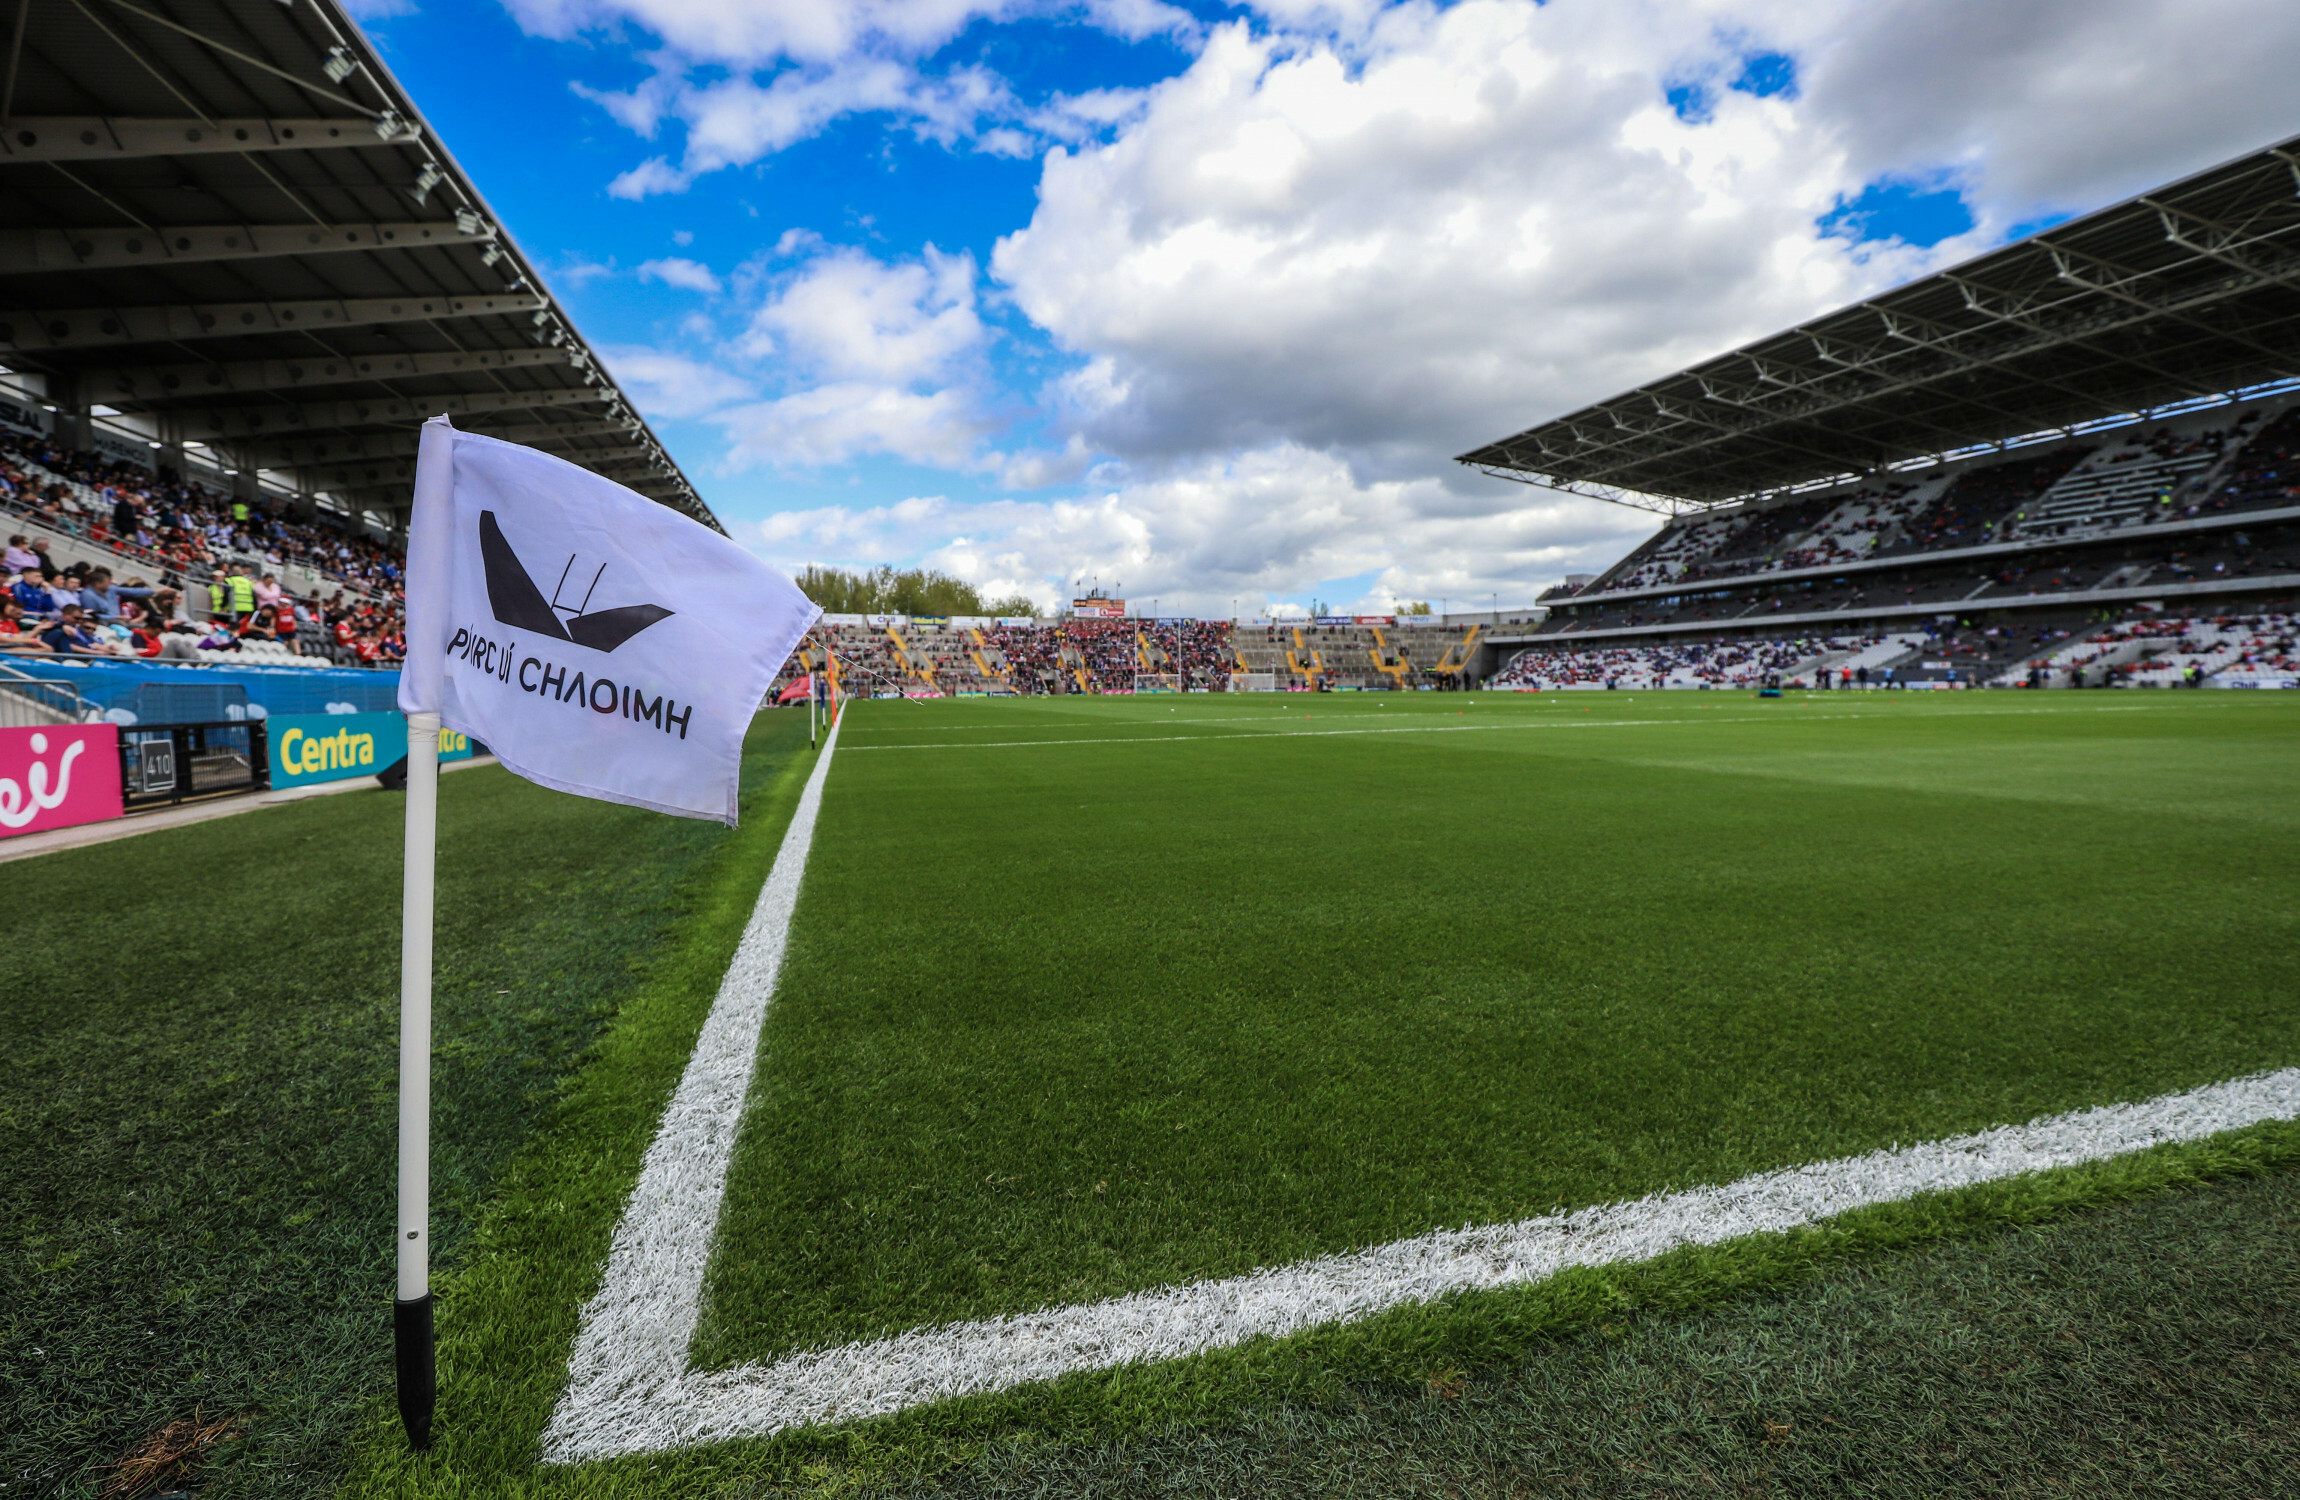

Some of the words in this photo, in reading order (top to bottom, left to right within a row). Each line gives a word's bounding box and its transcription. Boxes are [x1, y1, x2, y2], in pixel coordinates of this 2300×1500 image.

[147, 754, 171, 775] 410
[280, 727, 374, 776] Centra
[0, 733, 85, 828] eir
